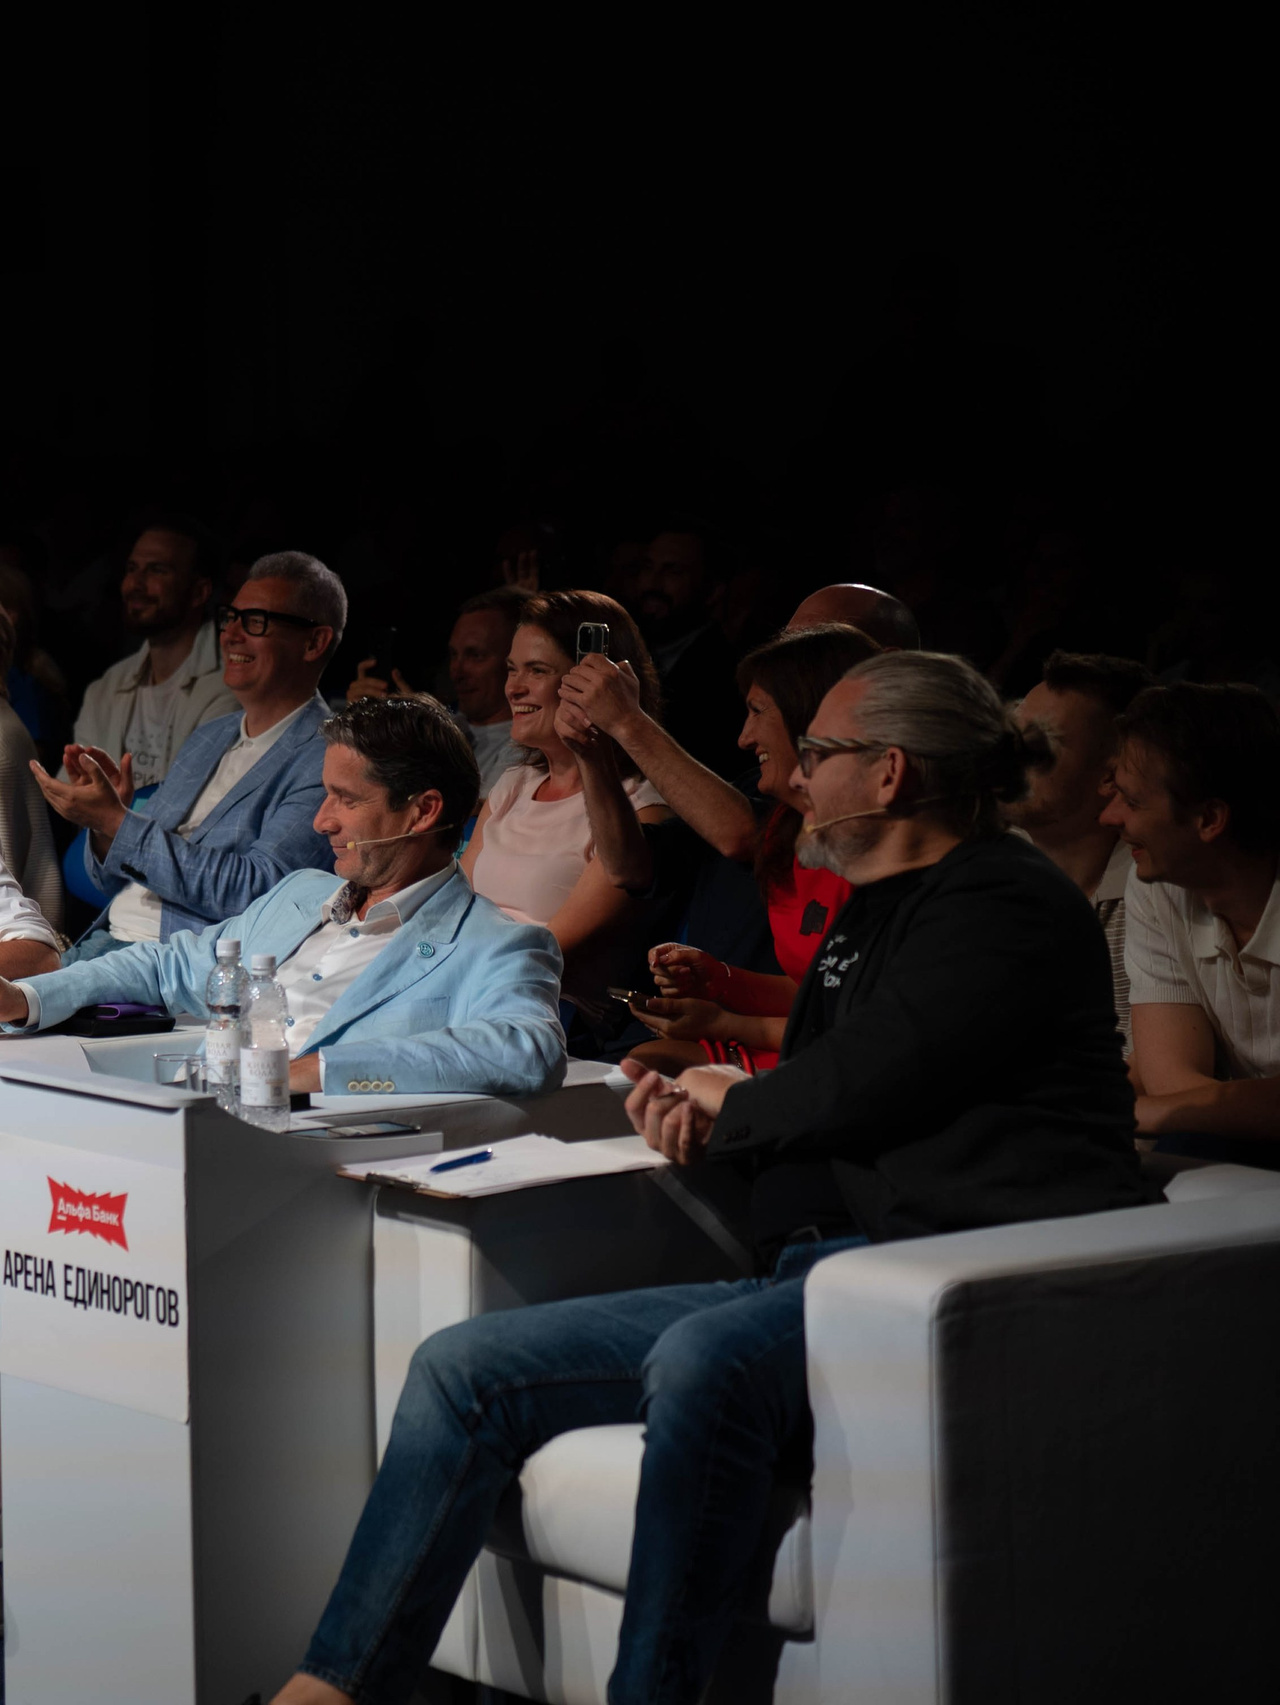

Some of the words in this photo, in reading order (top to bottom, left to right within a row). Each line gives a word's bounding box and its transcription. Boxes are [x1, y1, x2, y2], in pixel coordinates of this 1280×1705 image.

[57, 1198, 91, 1222] Альфа
[92, 1204, 120, 1227] Банк
[3, 1249, 56, 1298] АРЕНА
[63, 1263, 179, 1328] ЕДИНОРОГОВ
